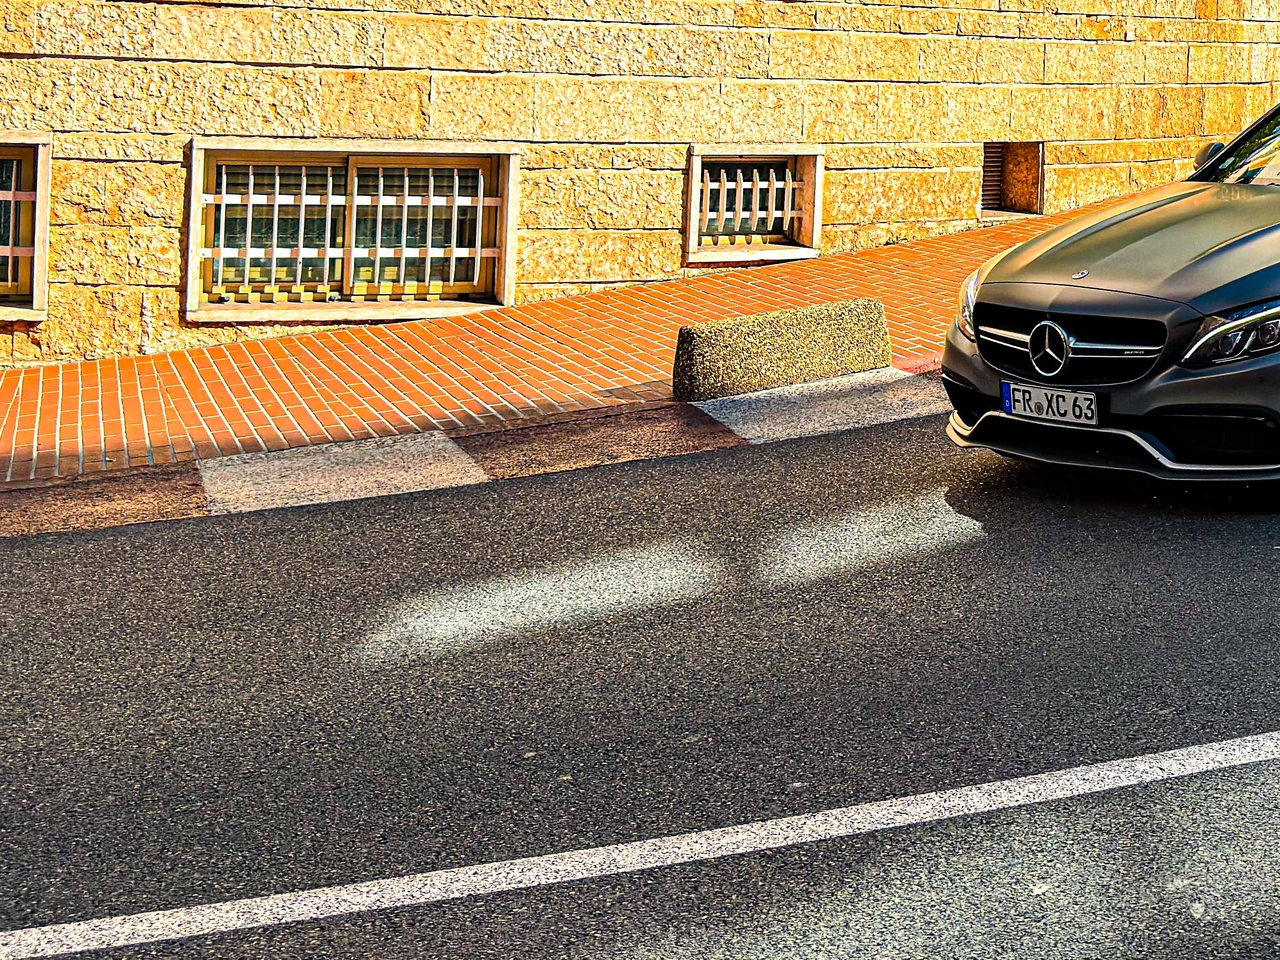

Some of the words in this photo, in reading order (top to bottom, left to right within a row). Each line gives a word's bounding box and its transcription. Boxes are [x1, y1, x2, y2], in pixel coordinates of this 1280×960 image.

[1012, 387, 1034, 413] FR
[1044, 392, 1068, 418] XC
[1072, 396, 1095, 420] 63
